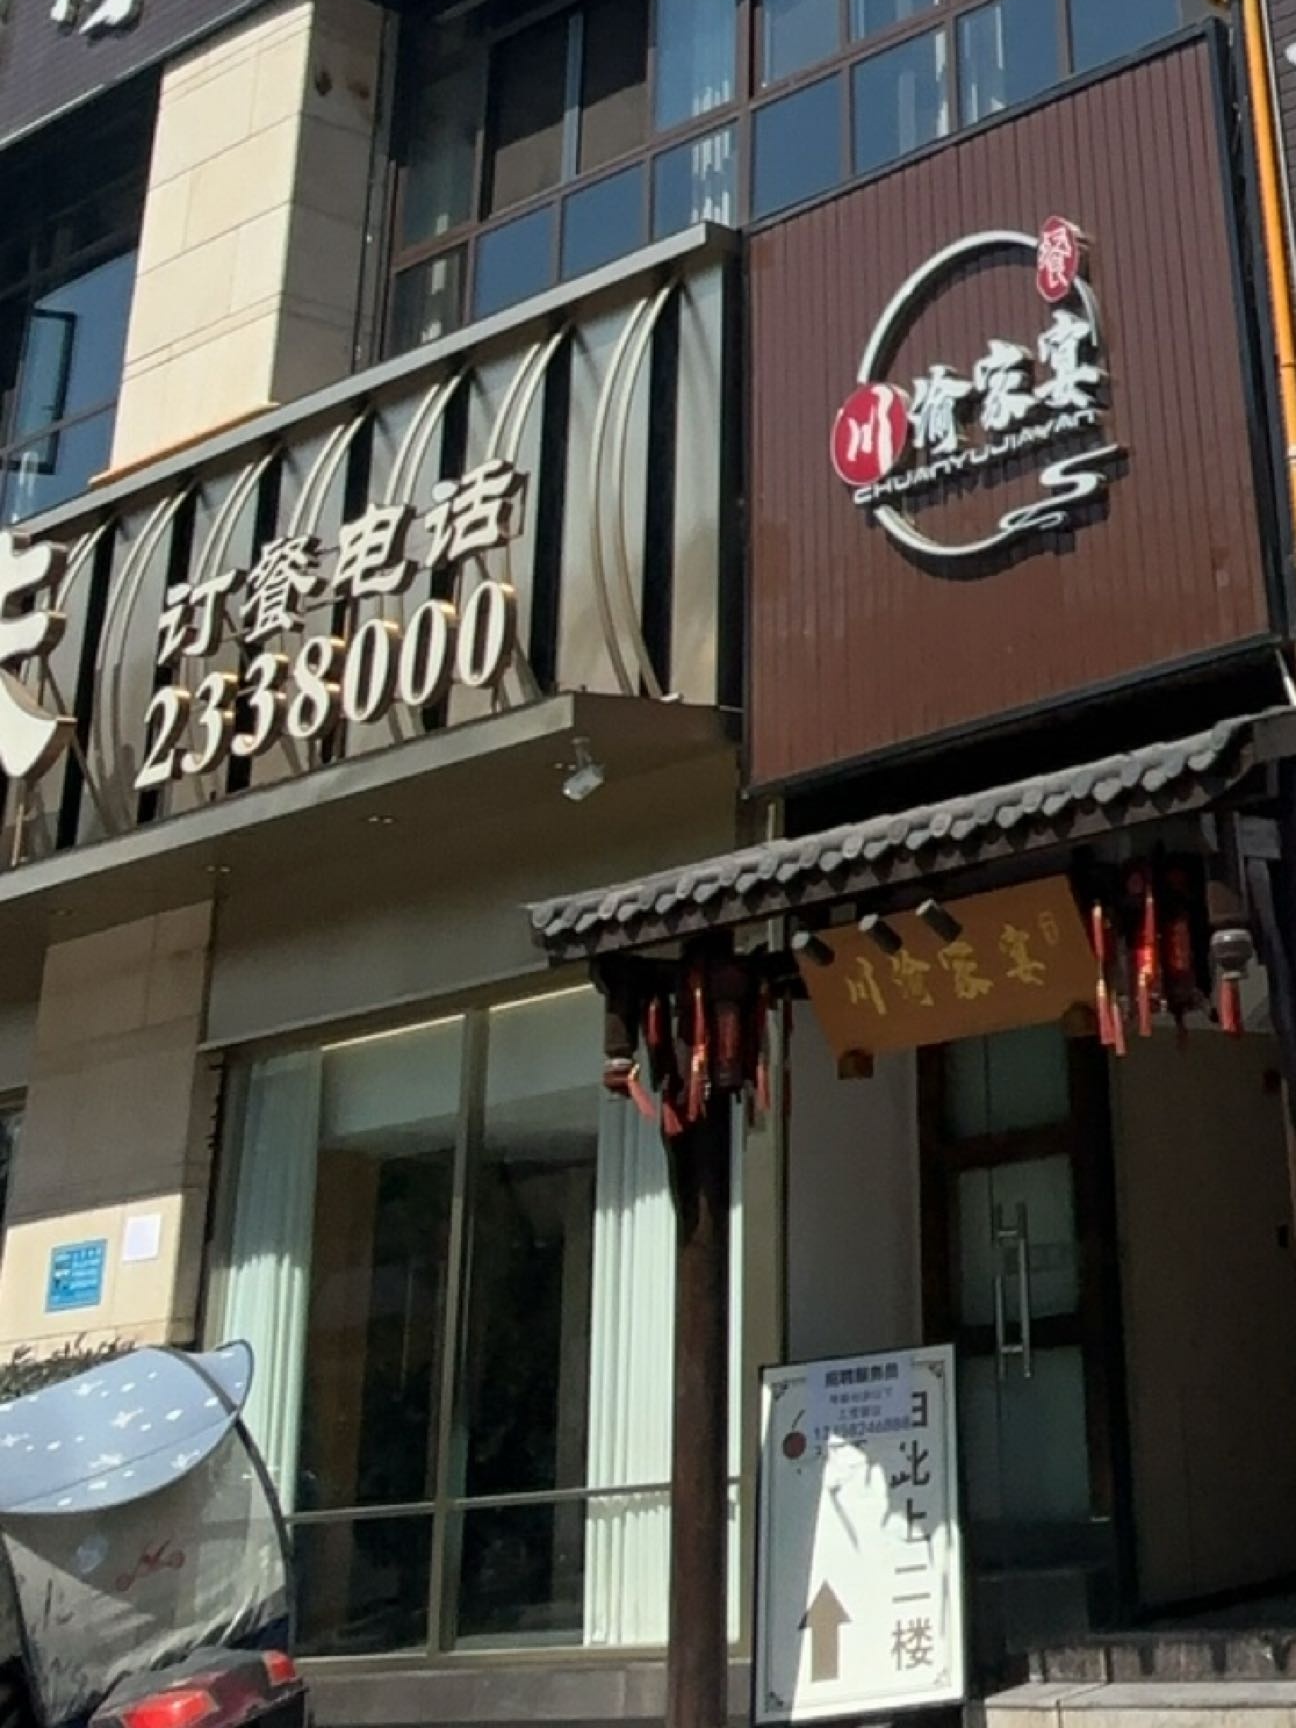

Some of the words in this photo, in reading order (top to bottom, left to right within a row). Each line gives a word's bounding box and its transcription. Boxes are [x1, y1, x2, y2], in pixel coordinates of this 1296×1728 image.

[159, 459, 517, 663] 订餐电话
[135, 581, 515, 790] 2338000
